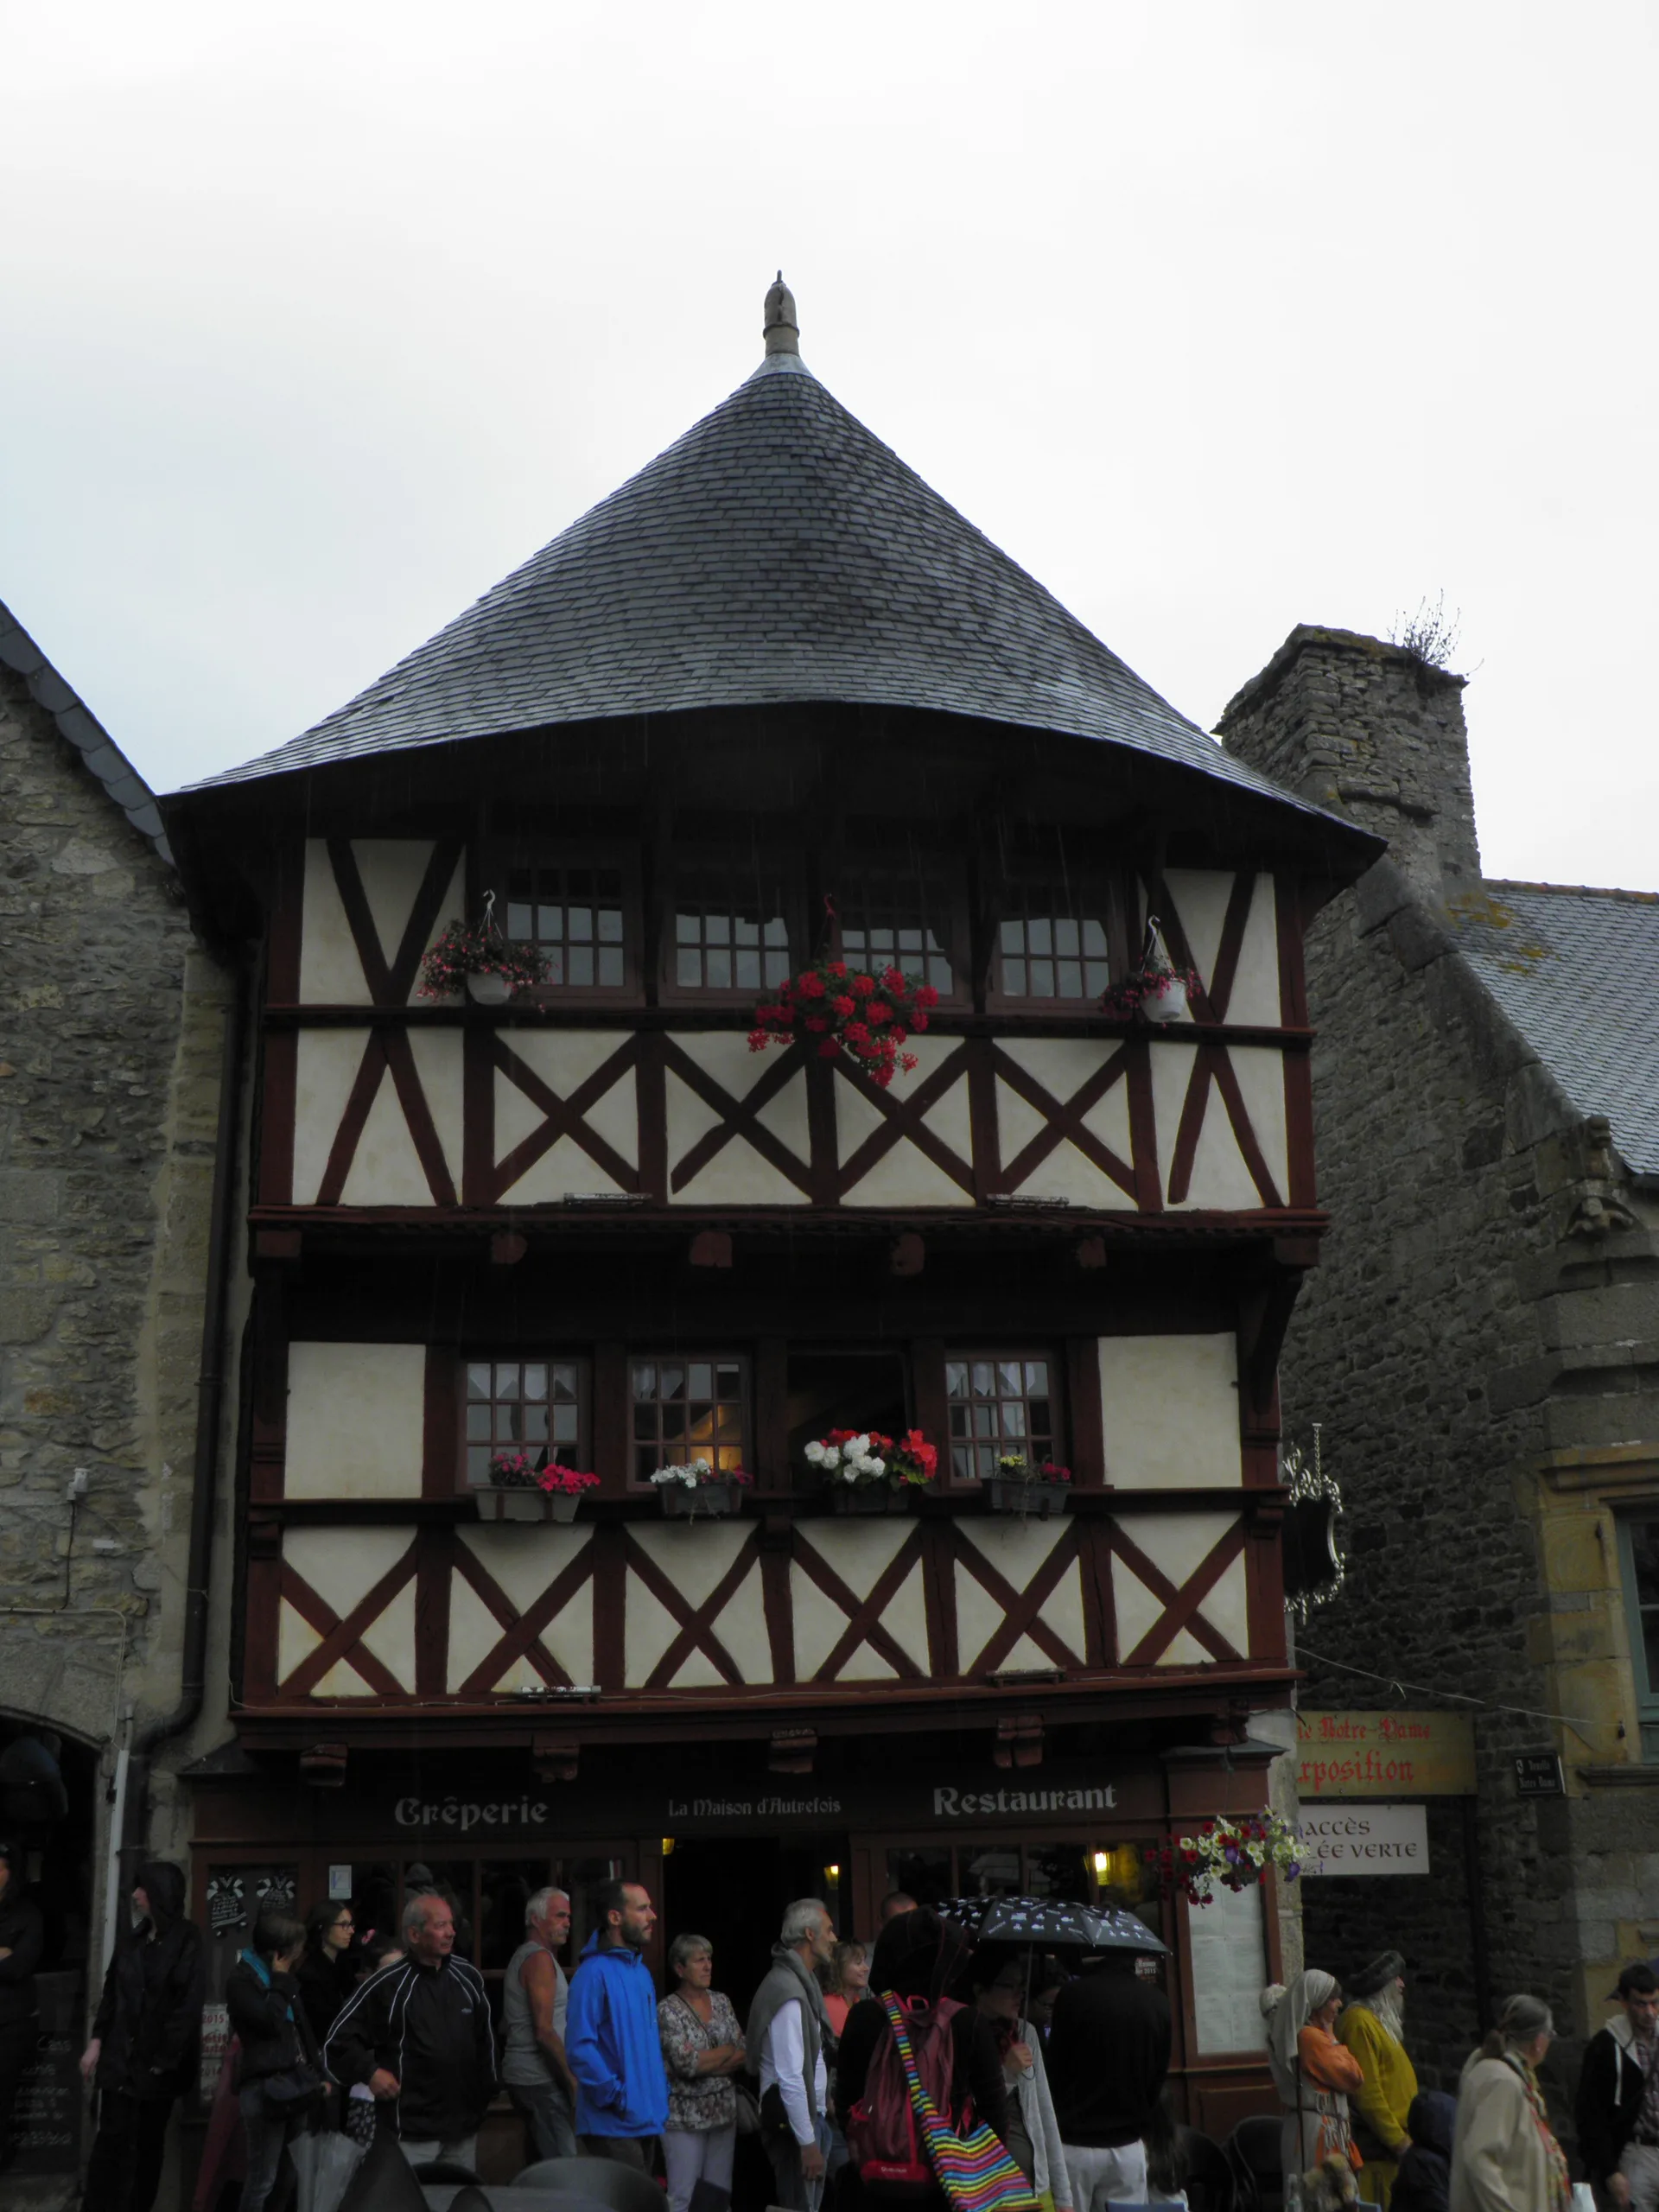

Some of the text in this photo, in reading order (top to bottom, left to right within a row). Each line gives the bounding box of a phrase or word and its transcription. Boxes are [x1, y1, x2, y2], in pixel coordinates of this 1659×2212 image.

[1319, 1715, 1431, 1742] Notre-Dame
[668, 1796, 842, 1817] La Maison d'Autrefois
[933, 1783, 1118, 1816] Restaurant
[394, 1795, 550, 1831] Crêperie
[1305, 1816, 1370, 1836] ACCÈS
[1351, 1842, 1417, 1859] VERTE
